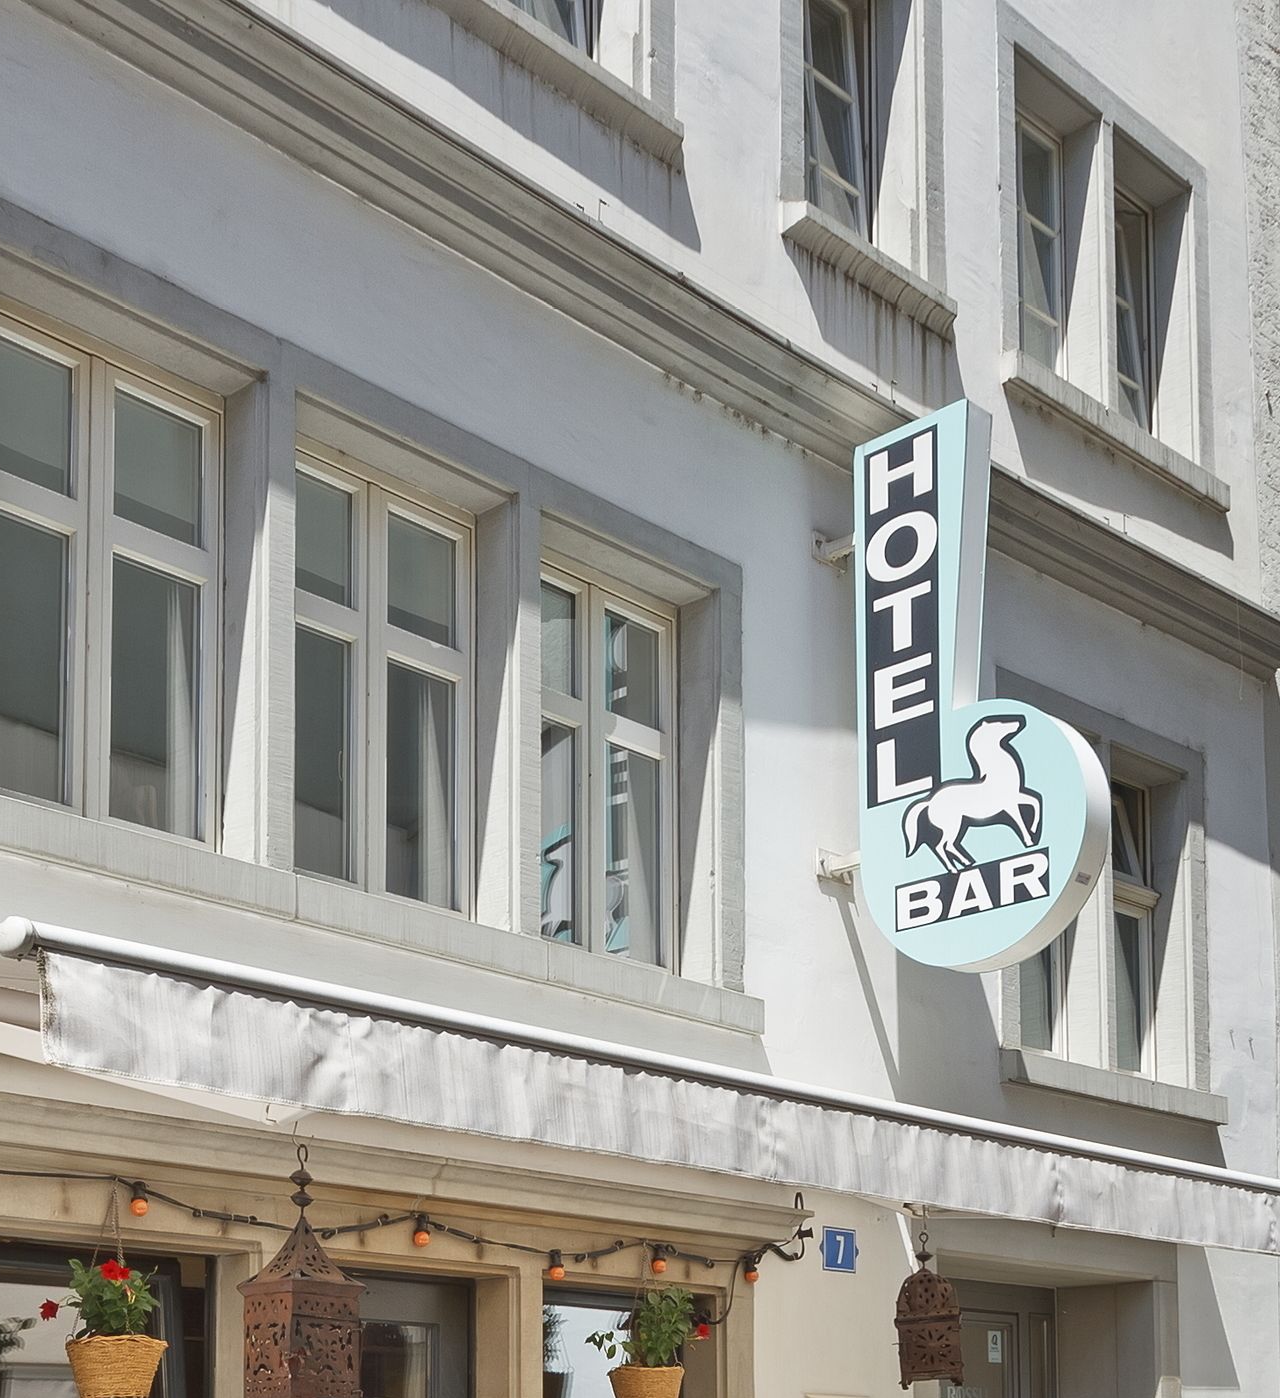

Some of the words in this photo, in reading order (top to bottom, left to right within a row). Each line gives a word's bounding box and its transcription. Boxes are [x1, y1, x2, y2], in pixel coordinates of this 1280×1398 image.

[865, 430, 939, 804] HOTEL
[897, 852, 1049, 932] BAR
[836, 1235, 845, 1264] 7
